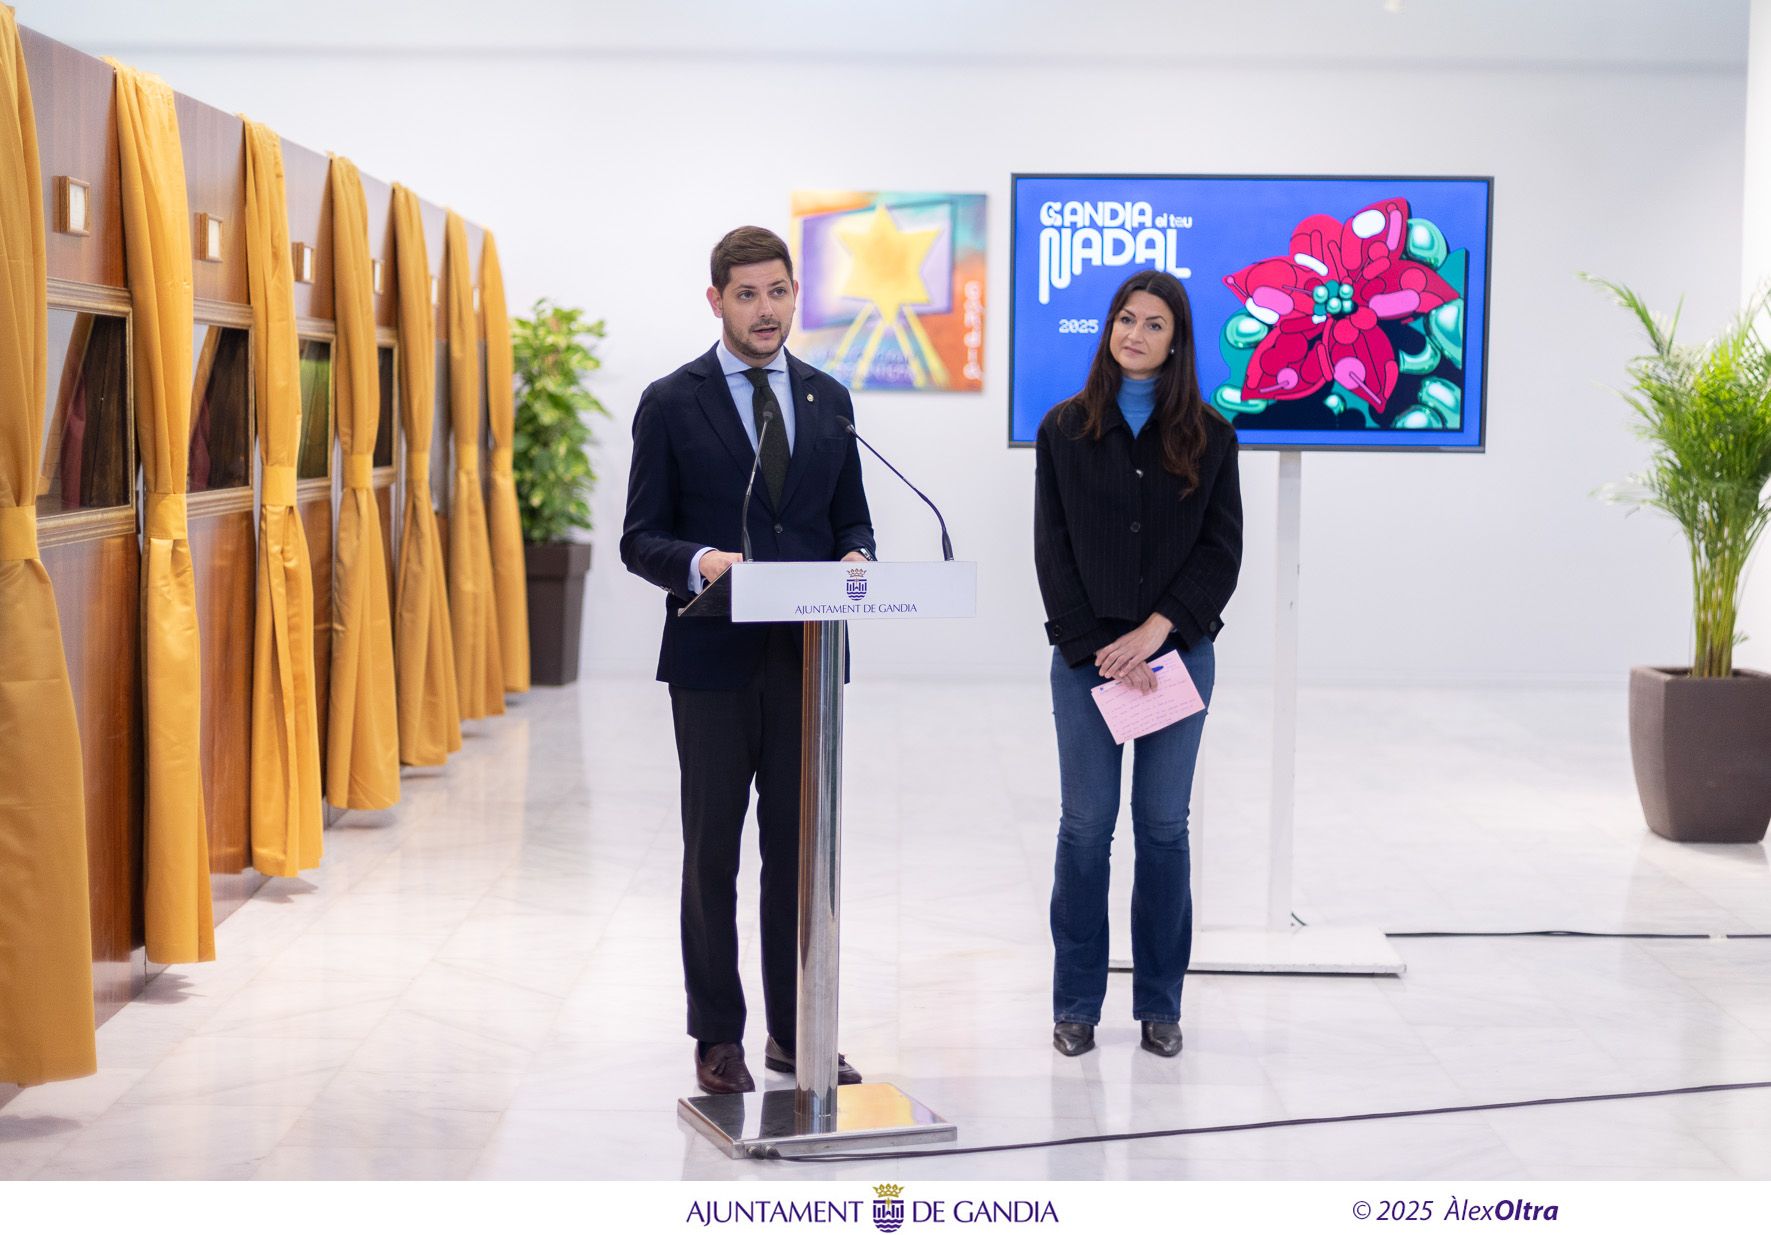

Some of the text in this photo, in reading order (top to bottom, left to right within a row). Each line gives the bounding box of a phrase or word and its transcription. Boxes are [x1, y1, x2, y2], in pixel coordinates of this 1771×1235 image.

[1039, 200, 1153, 228] GANDIA
[1038, 227, 1192, 305] NADAL
[1058, 318, 1099, 334] 2025
[795, 603, 918, 616] AJUNTAMENT DE GANDIA
